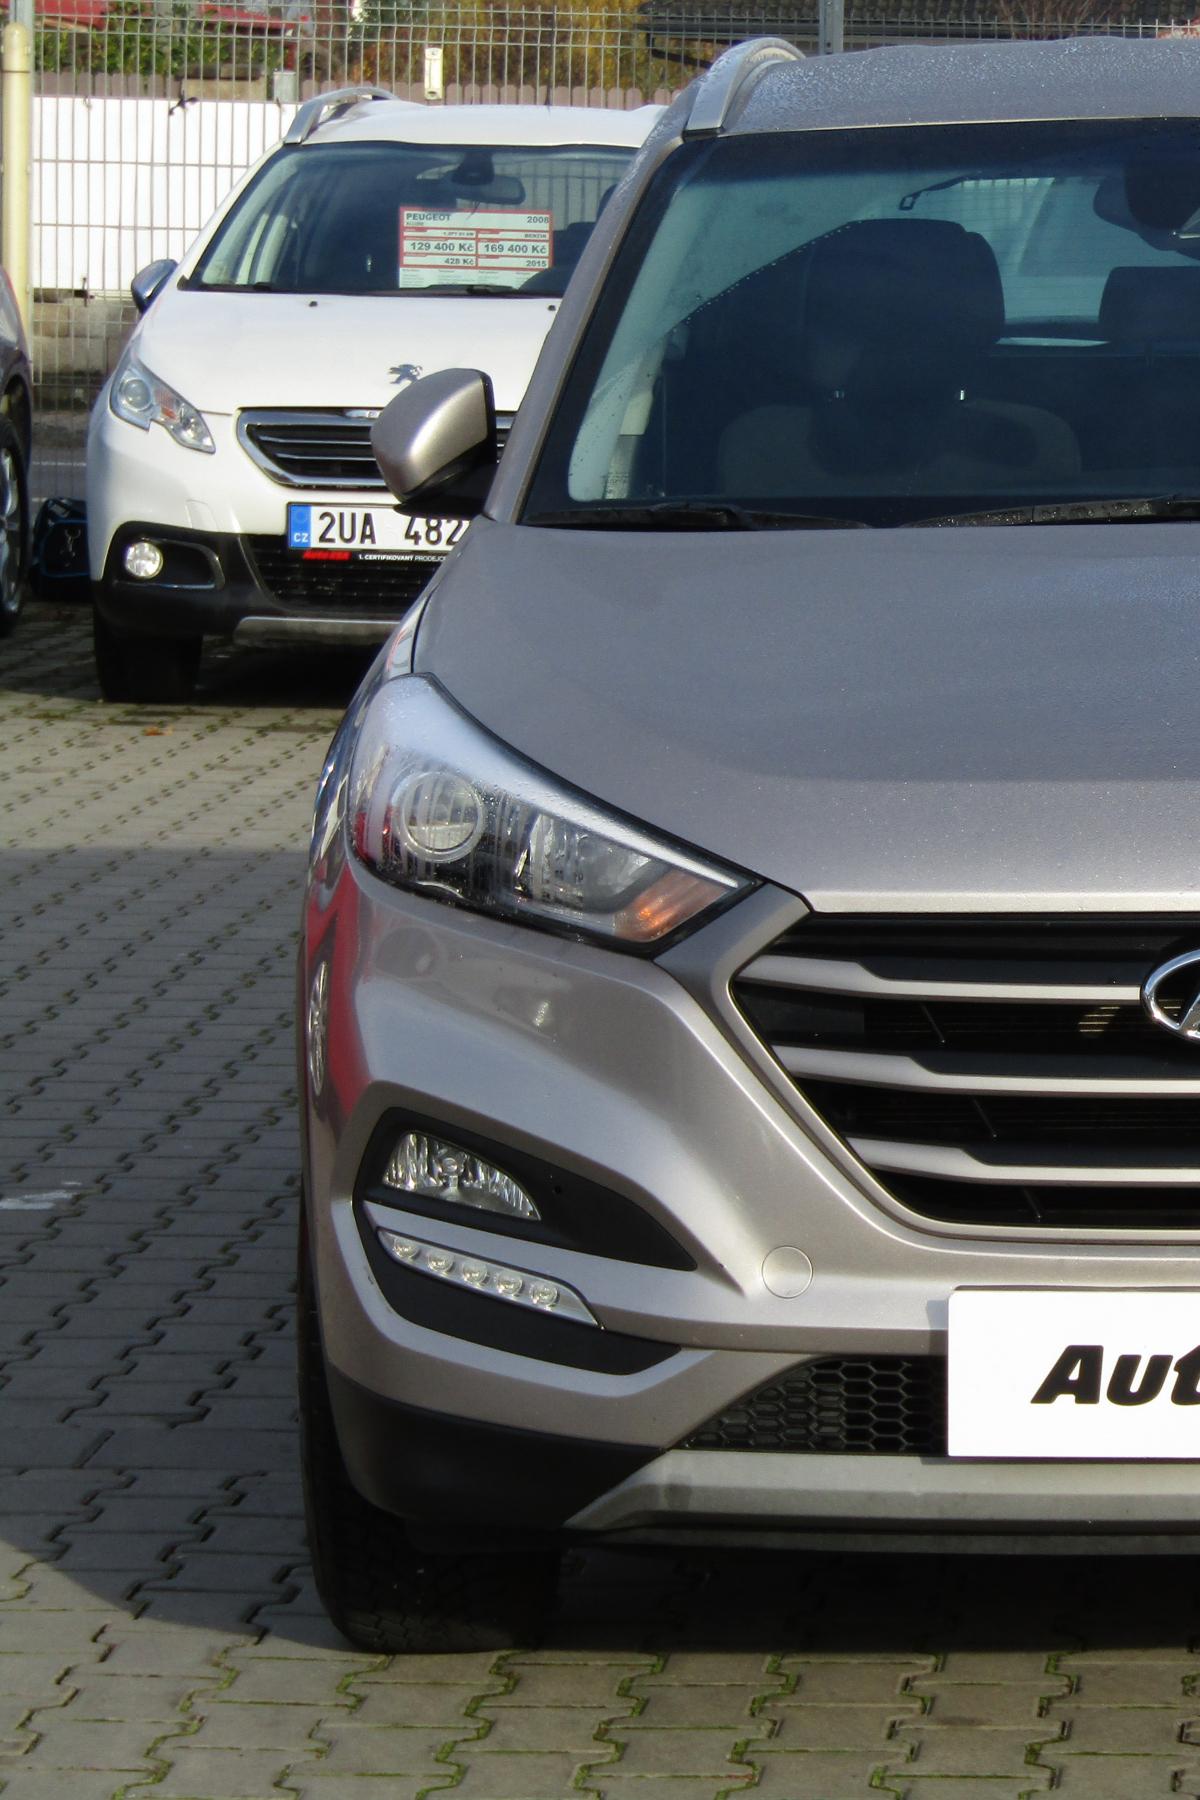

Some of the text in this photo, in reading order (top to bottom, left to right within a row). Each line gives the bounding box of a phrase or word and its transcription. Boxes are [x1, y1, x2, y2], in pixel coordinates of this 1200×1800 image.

[406, 212, 451, 221] PEUGEOT
[527, 215, 549, 224] 2008
[410, 241, 475, 252] 129 400 Kč
[484, 243, 547, 254] 169 400 Kč
[526, 259, 547, 267] 2015
[318, 511, 463, 546] 2UA 482
[293, 532, 309, 543] CZ
